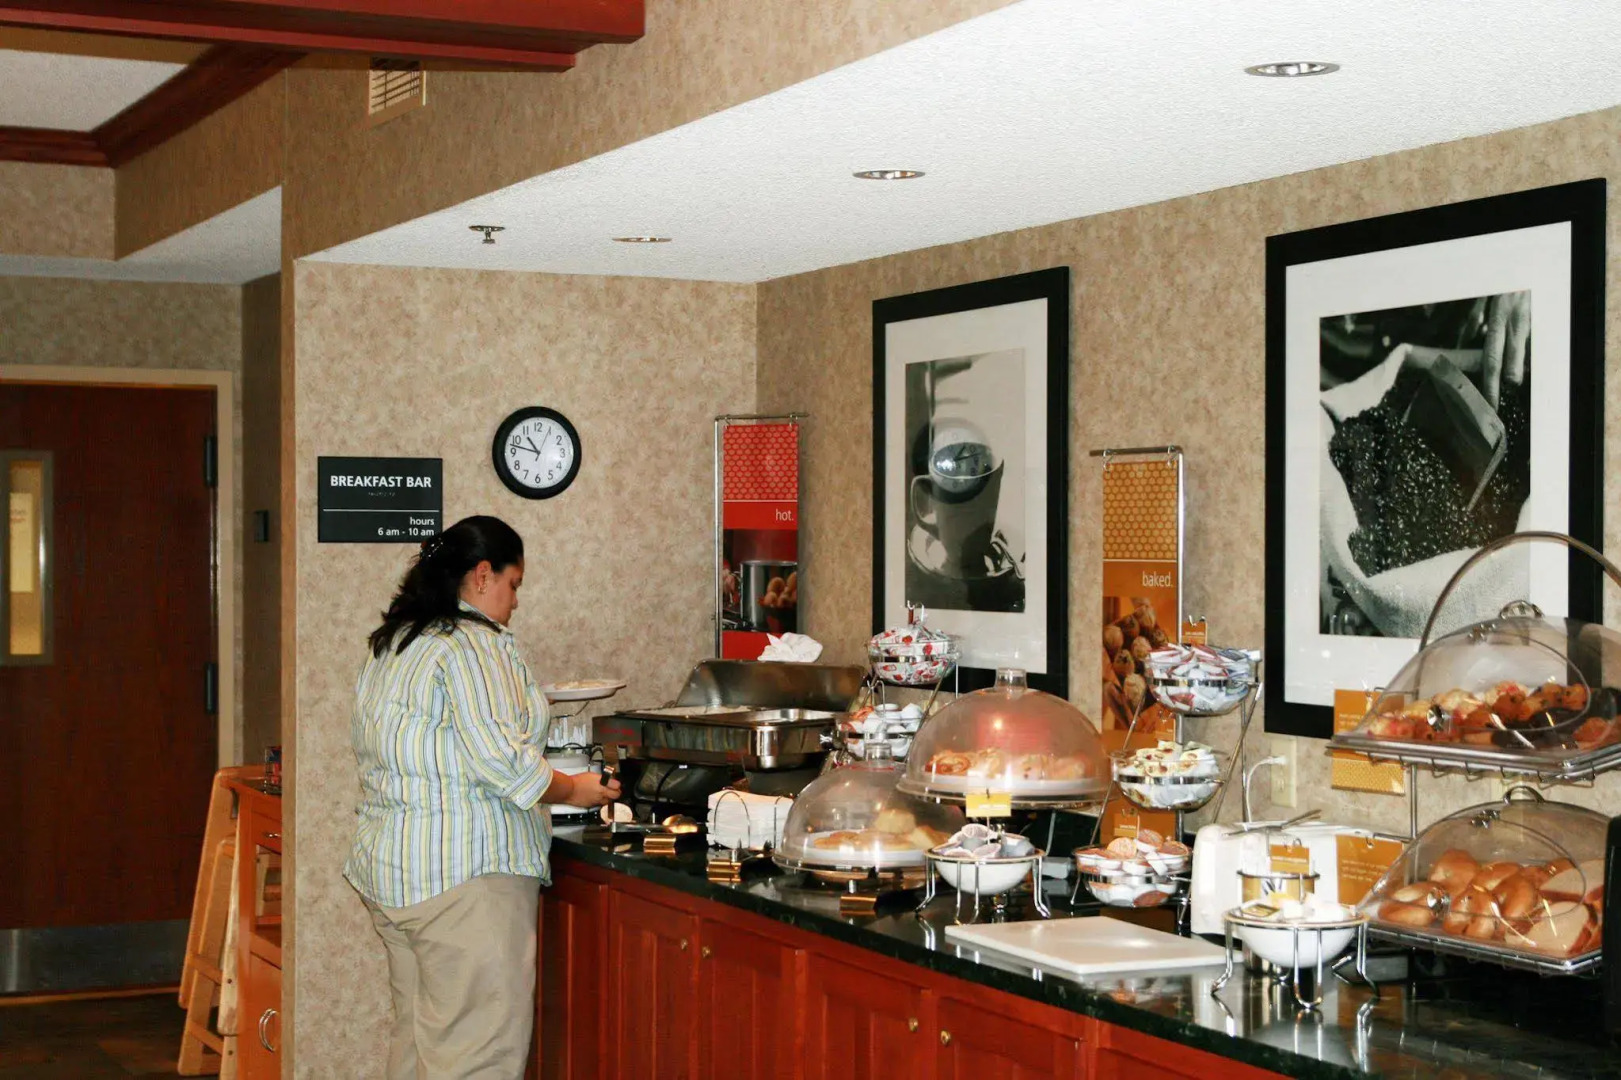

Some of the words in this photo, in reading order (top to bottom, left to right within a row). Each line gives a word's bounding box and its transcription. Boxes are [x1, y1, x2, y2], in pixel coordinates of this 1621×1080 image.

[522, 425, 529, 435] 11
[534, 422, 542, 432] 12
[512, 435, 522, 445] 10
[556, 435, 562, 446] 2
[510, 447, 516, 458] 9
[560, 448, 566, 458] 3
[514, 460, 520, 470] 8
[556, 462, 562, 470] 4
[523, 470, 529, 480] 7
[534, 474, 541, 484] 6
[548, 470, 554, 480] 5
[330, 475, 403, 488] BREAKFAST
[406, 476, 432, 488] BAR
[775, 508, 794, 521] hot.
[409, 516, 435, 526] hours
[377, 527, 384, 536] 6
[385, 528, 400, 536] am
[408, 527, 418, 536] 10
[420, 528, 435, 536] am
[1142, 570, 1174, 587] baked.
